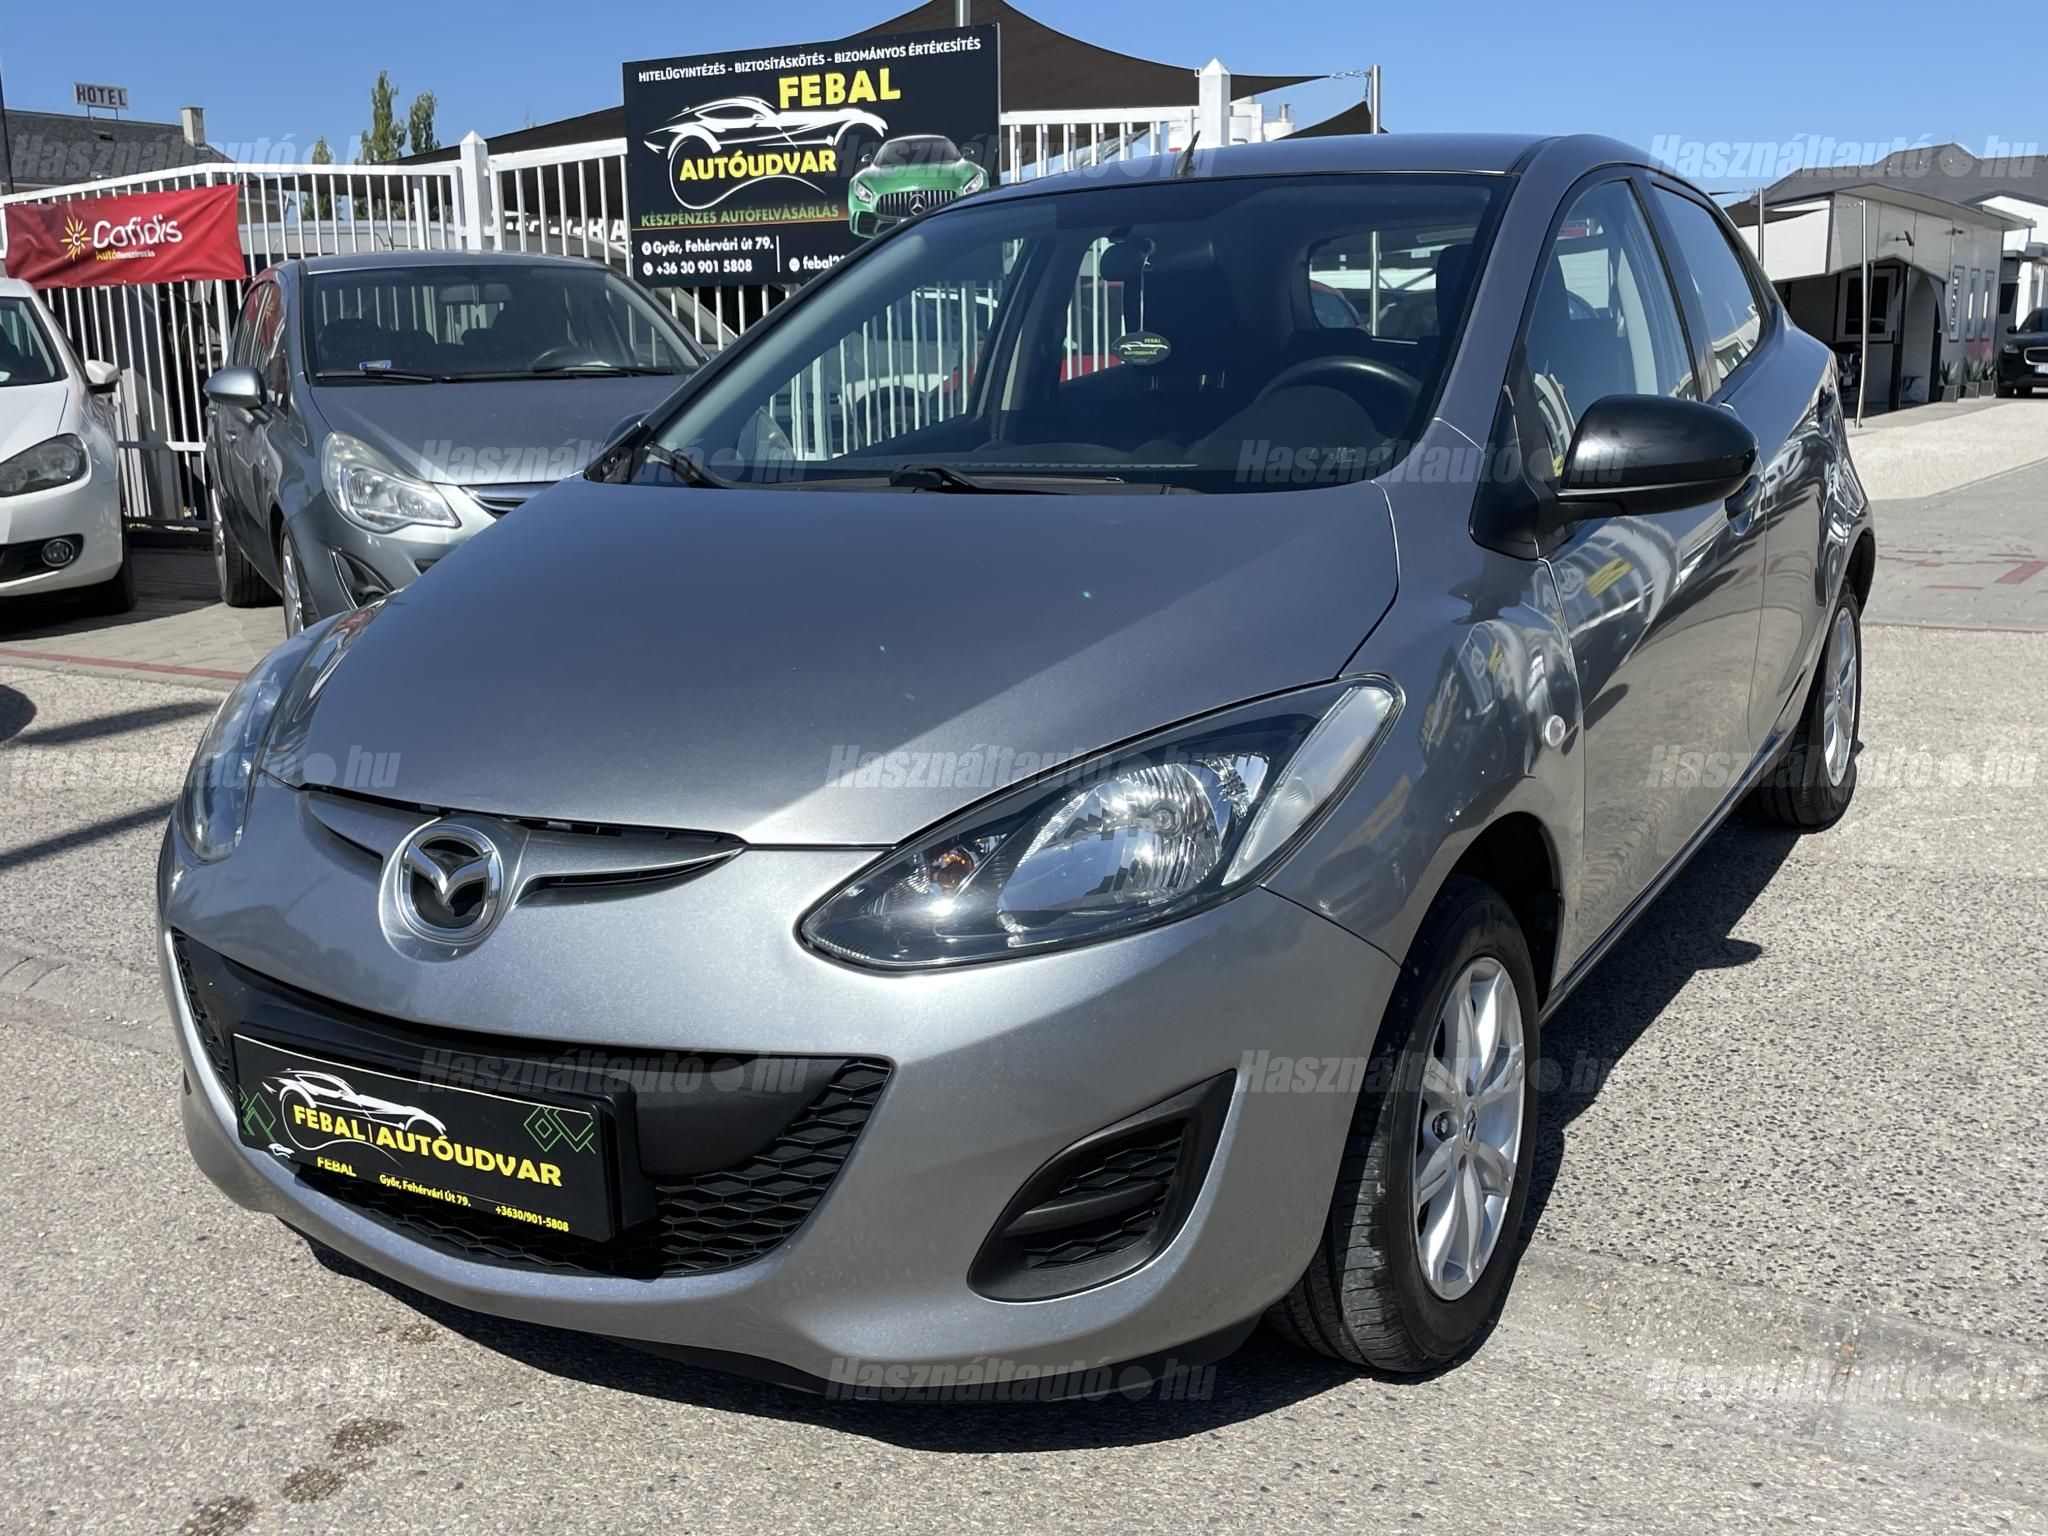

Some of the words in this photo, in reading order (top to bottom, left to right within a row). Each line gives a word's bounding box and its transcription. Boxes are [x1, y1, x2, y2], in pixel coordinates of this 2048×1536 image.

[734, 52, 825, 73] BIZTOSÍTÁSKÖTÉS
[834, 46, 907, 64] BIZOMÁNYOS
[908, 36, 982, 57] ÉRTÉKESÍTÉS
[76, 85, 127, 106] HOTEL
[778, 67, 901, 109] FEBAL
[679, 149, 837, 182] AUTÓUDVAR
[641, 208, 717, 227] KÉSZPÉNZES
[720, 203, 840, 223] AUTÓFELVÁSÁRLÁS
[92, 214, 183, 249] Cofidis
[652, 241, 683, 257] Győr,
[685, 238, 739, 253] Fehérvári
[740, 237, 753, 250] út
[755, 236, 774, 250] 79.
[656, 261, 678, 275] +36
[680, 260, 695, 274] 30
[697, 260, 719, 273] 901
[723, 259, 753, 273] 5808
[293, 1104, 367, 1142] FEBAL
[376, 1124, 563, 1187] AUTÓUDVAR
[317, 1156, 357, 1178] FEBAL
[379, 1173, 402, 1190] Győr,
[402, 1179, 444, 1201] Fehérvári
[444, 1190, 457, 1203] Út
[457, 1194, 472, 1207] 79.
[495, 1205, 570, 1233] +3630/901-5808
